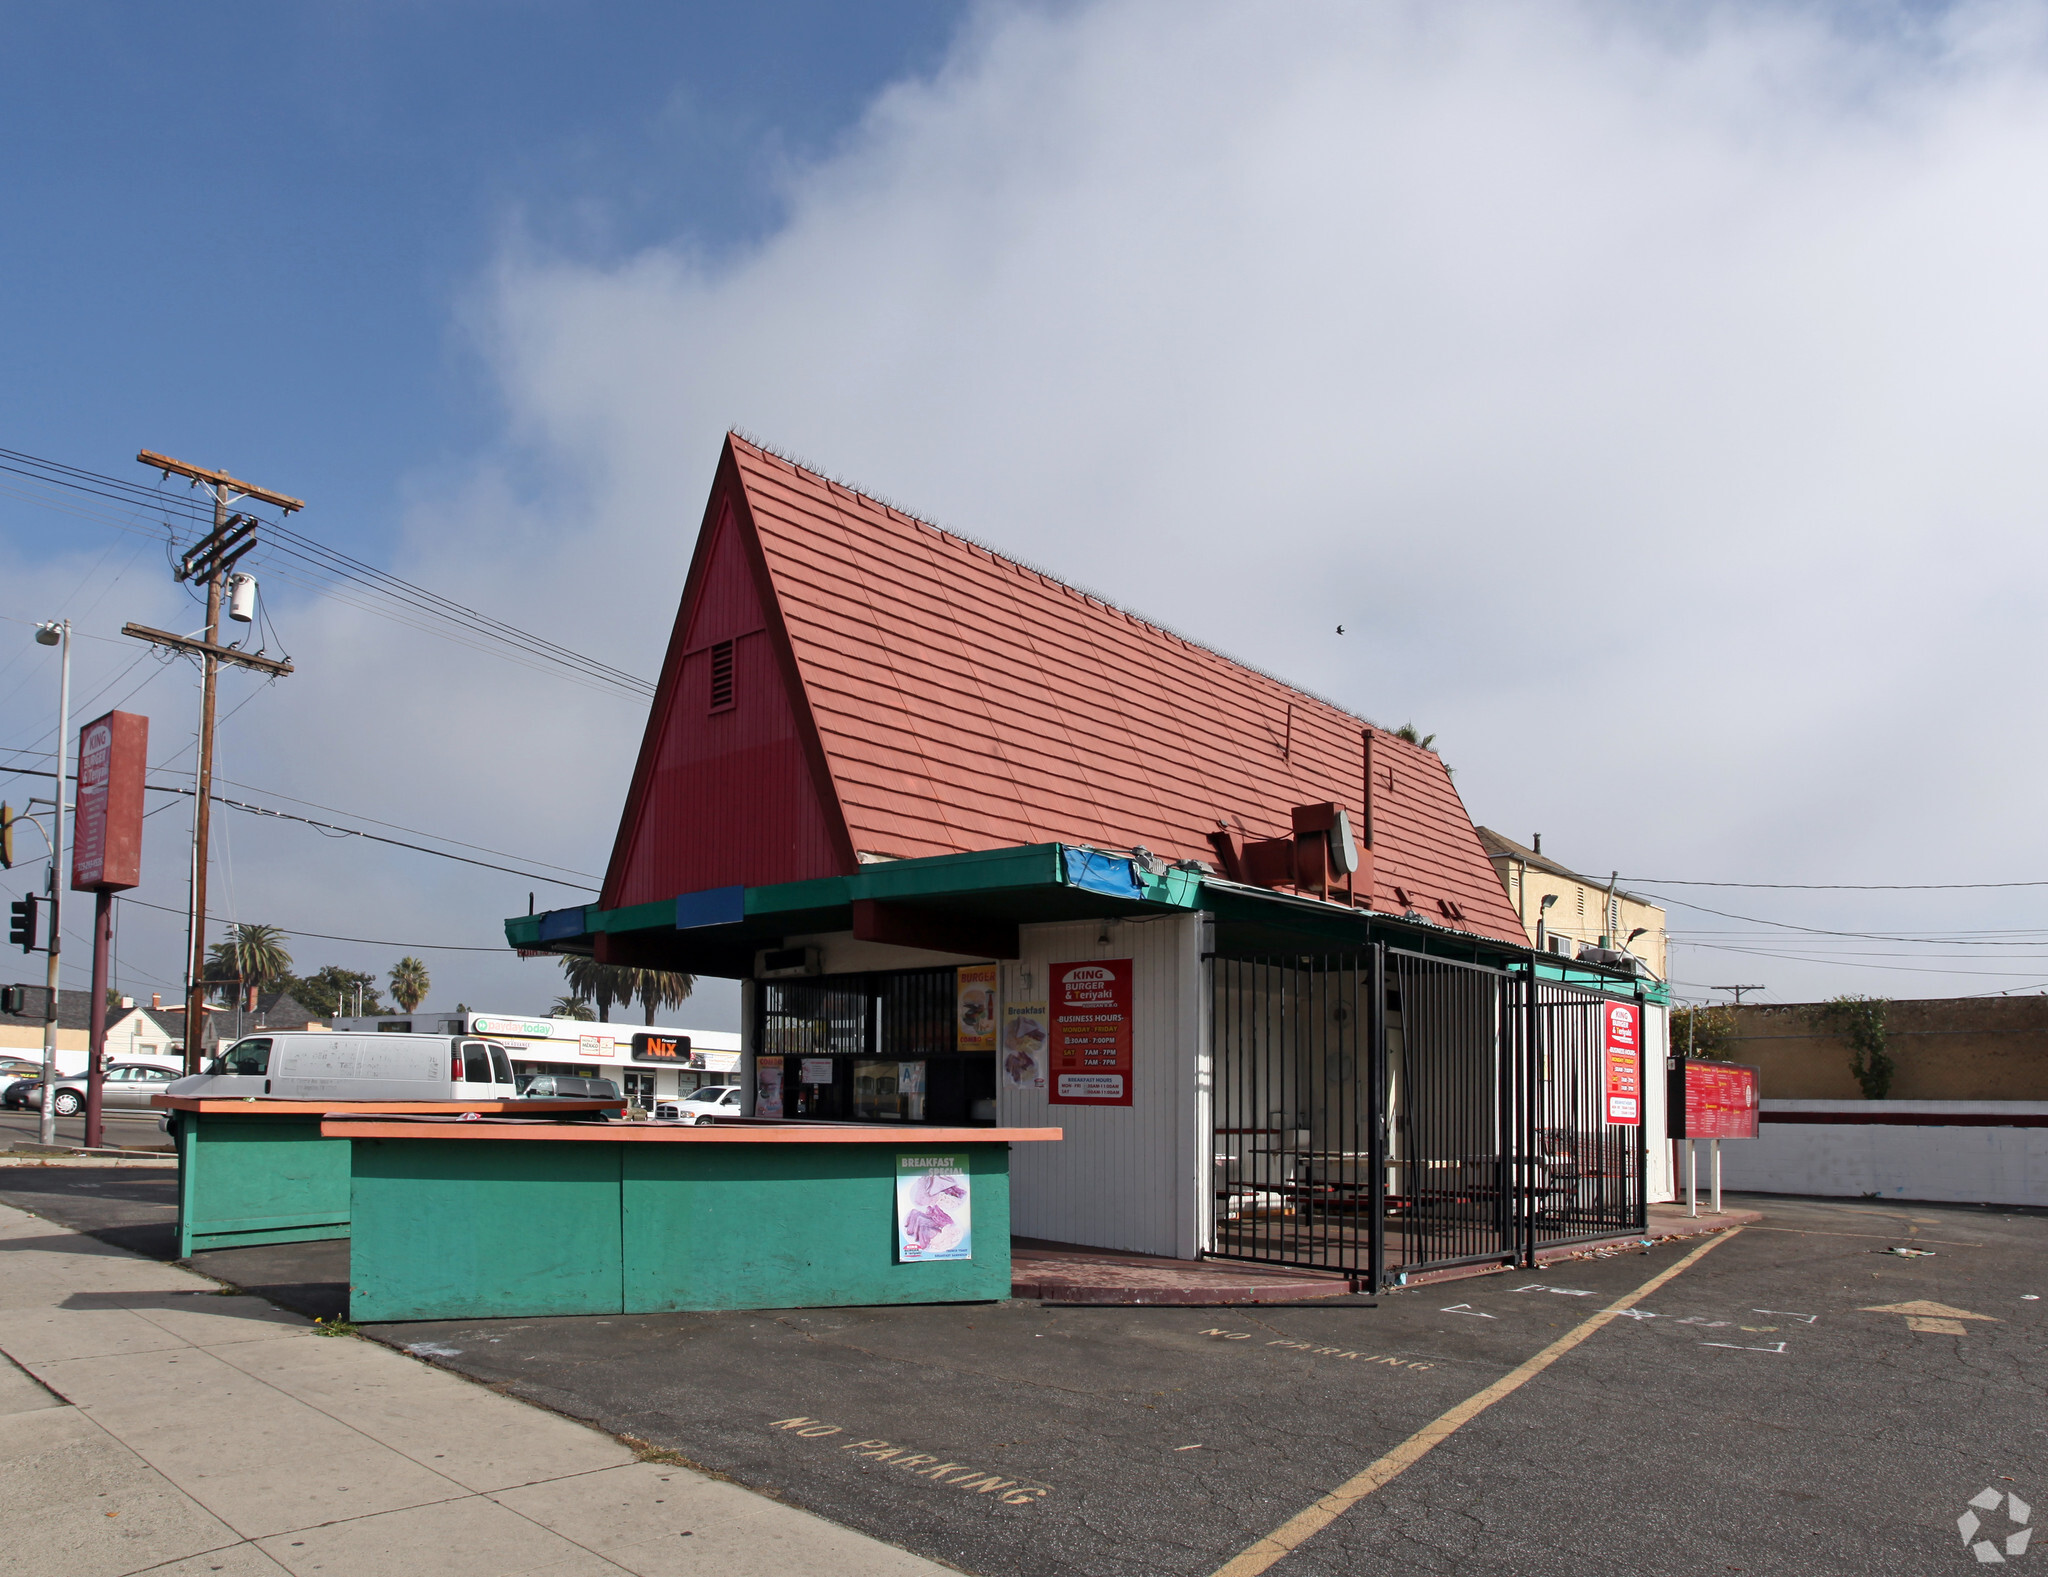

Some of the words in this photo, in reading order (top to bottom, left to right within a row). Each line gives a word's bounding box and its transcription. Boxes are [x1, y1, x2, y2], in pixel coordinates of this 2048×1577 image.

[89, 730, 106, 750] KING
[83, 749, 106, 769] BURGER
[961, 972, 996, 983] BURGER
[1073, 969, 1103, 980] KING
[1065, 982, 1105, 991] BURGER
[1065, 991, 1072, 1000] &
[1074, 990, 1113, 1001] Teriyaki
[1008, 1006, 1046, 1015] Breakfast
[1616, 1010, 1628, 1020] KING
[1612, 1019, 1629, 1028] BURGER
[647, 1038, 677, 1057] Nix
[903, 1068, 911, 1082] A
[901, 1158, 955, 1168] BREAKFAST
[928, 1168, 964, 1177] SPECIAL
[1198, 1328, 1251, 1340] NO
[1265, 1340, 1435, 1371] PARKING
[769, 1417, 843, 1438] NO
[840, 1439, 1048, 1505] PARKING
